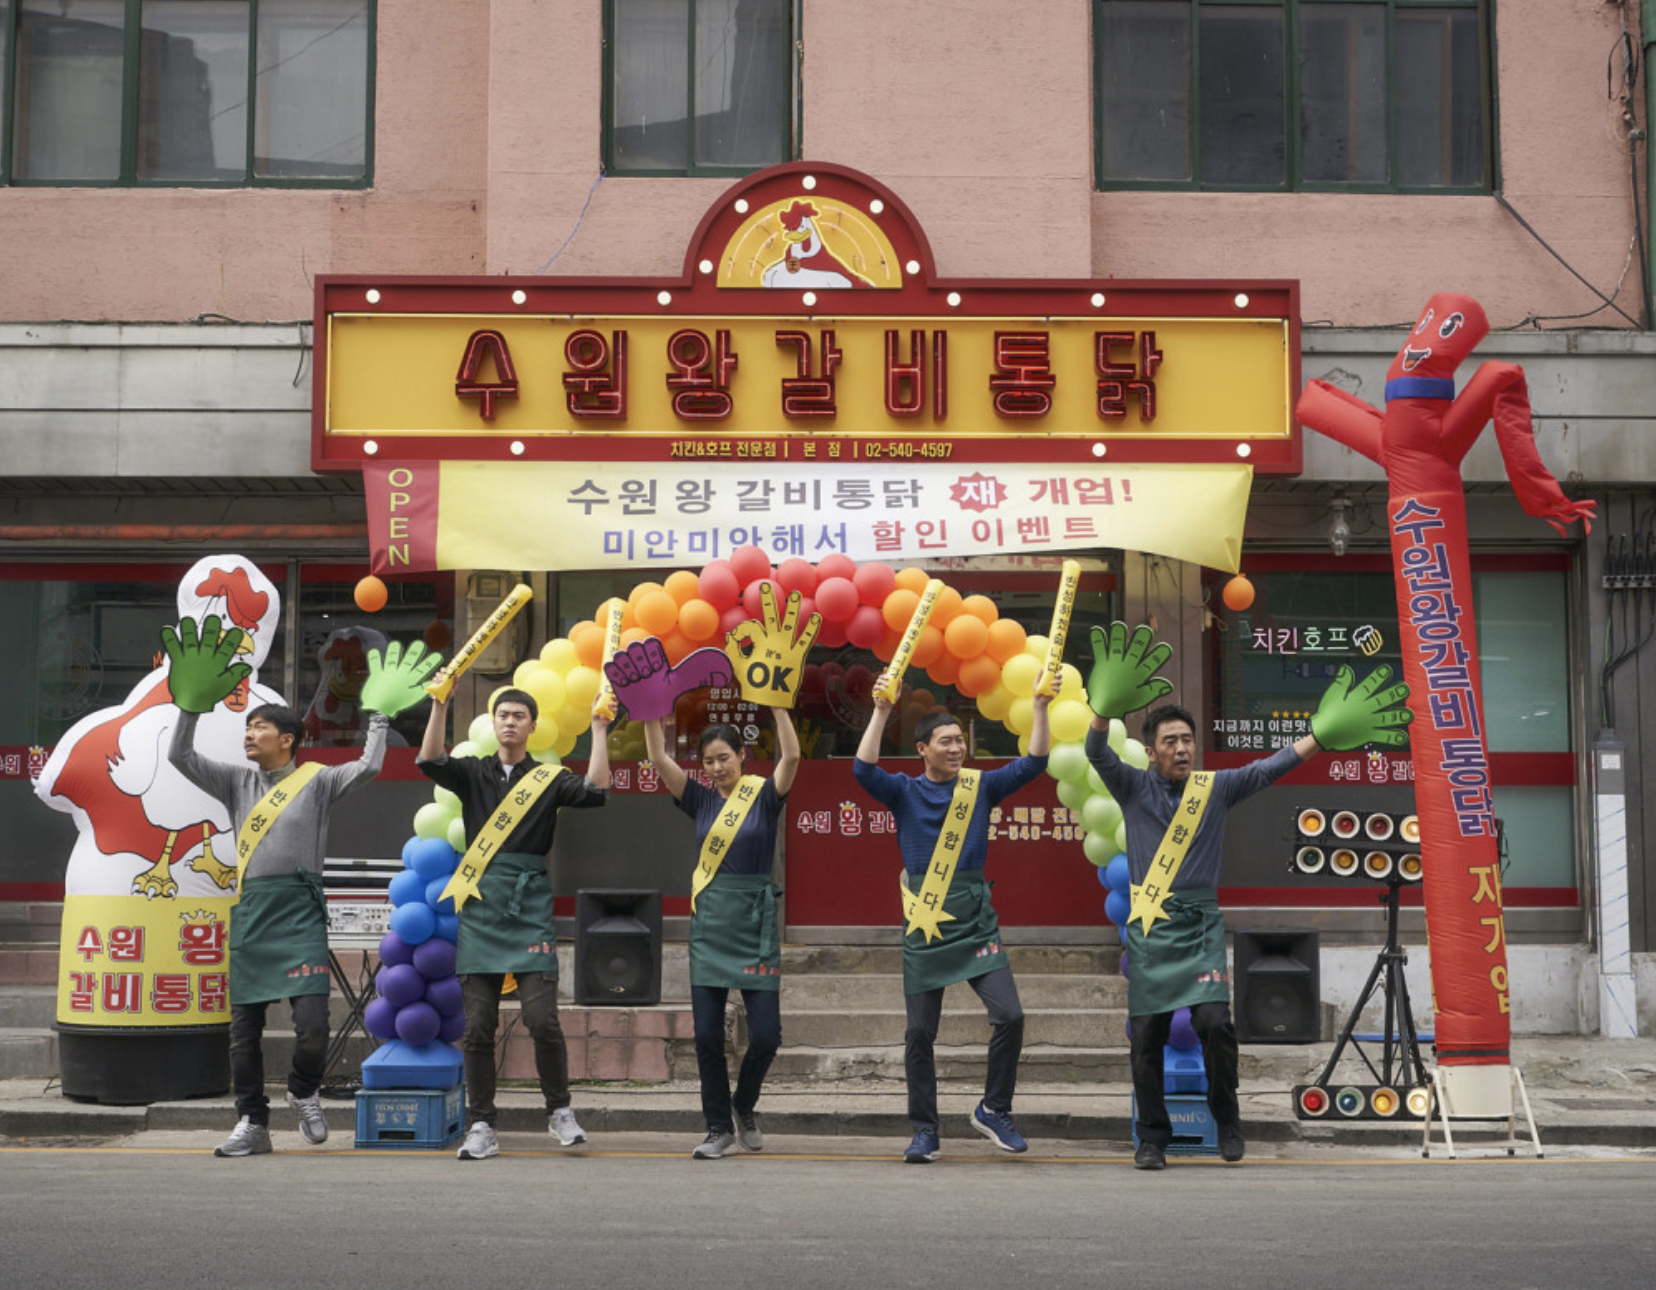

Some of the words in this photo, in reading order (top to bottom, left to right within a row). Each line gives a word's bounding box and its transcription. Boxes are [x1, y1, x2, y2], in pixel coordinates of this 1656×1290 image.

[455, 329, 1164, 423] 수원왕갈비통닭
[670, 441, 732, 457] 치킨&호프
[736, 441, 777, 457] 전문점
[865, 442, 953, 457] 02-540-4597
[387, 467, 414, 567] OPEN
[567, 479, 657, 515] 수원
[736, 479, 924, 512] 갈비통닭
[959, 480, 998, 508] 재
[1028, 477, 1133, 506] 개업!
[603, 522, 848, 560] 미안미안해서
[872, 520, 948, 551] 할인
[971, 516, 1099, 547] 이벤트
[746, 661, 795, 693] OK
[1392, 498, 1496, 838] 수원왕갈비통닭
[1213, 719, 1265, 732] 지금까지
[638, 766, 660, 792] 왕
[1330, 760, 1361, 781] 수원
[1367, 756, 1389, 784] 왕
[461, 768, 551, 884] 반성합니다
[797, 811, 831, 834] 수원
[839, 807, 863, 837] 왕
[922, 775, 976, 912] 반성합니다
[1144, 773, 1210, 904] 반성합니다
[77, 925, 145, 963] 수원
[178, 920, 228, 966] 왕
[69, 971, 229, 1014] 갈비통닭
